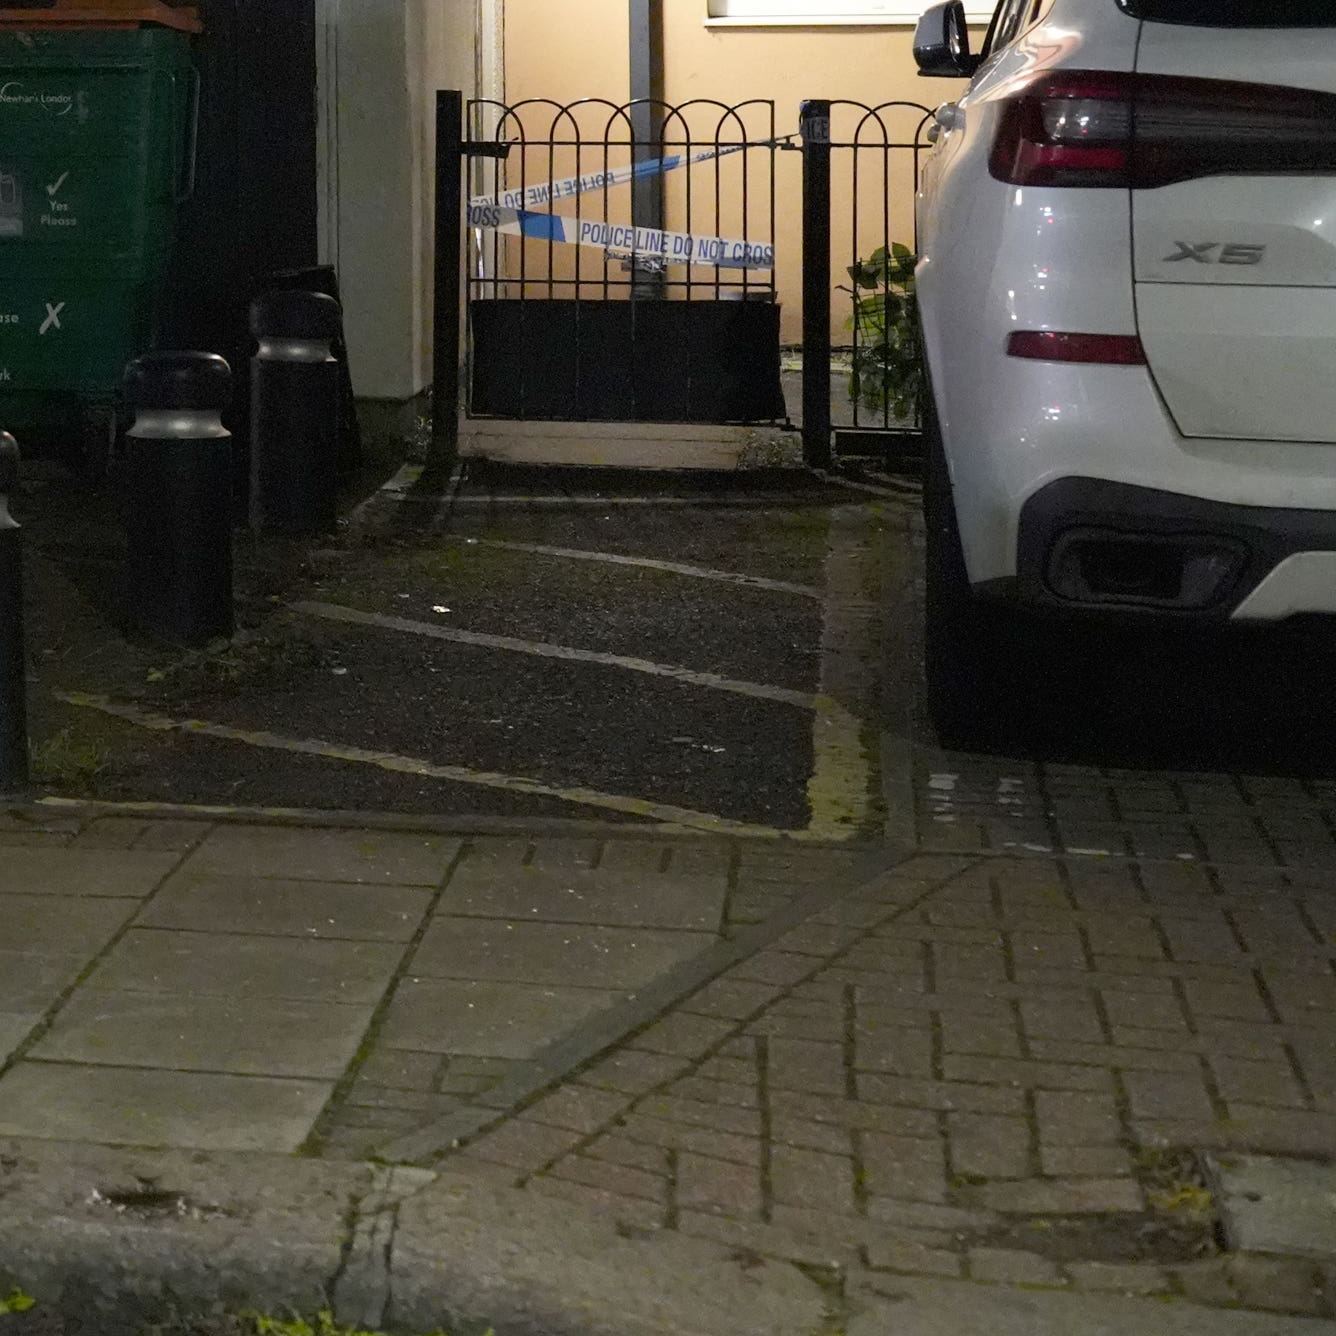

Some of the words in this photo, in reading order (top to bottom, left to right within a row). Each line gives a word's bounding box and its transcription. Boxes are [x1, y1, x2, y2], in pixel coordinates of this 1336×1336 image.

[49, 200, 69, 212] Yes
[40, 215, 78, 227] Please
[581, 222, 633, 248] POLICE
[636, 231, 669, 253] LINE
[673, 235, 693, 257] DO
[698, 238, 729, 261] NOT
[732, 242, 774, 266] CROS
[1161, 239, 1266, 267] X5
